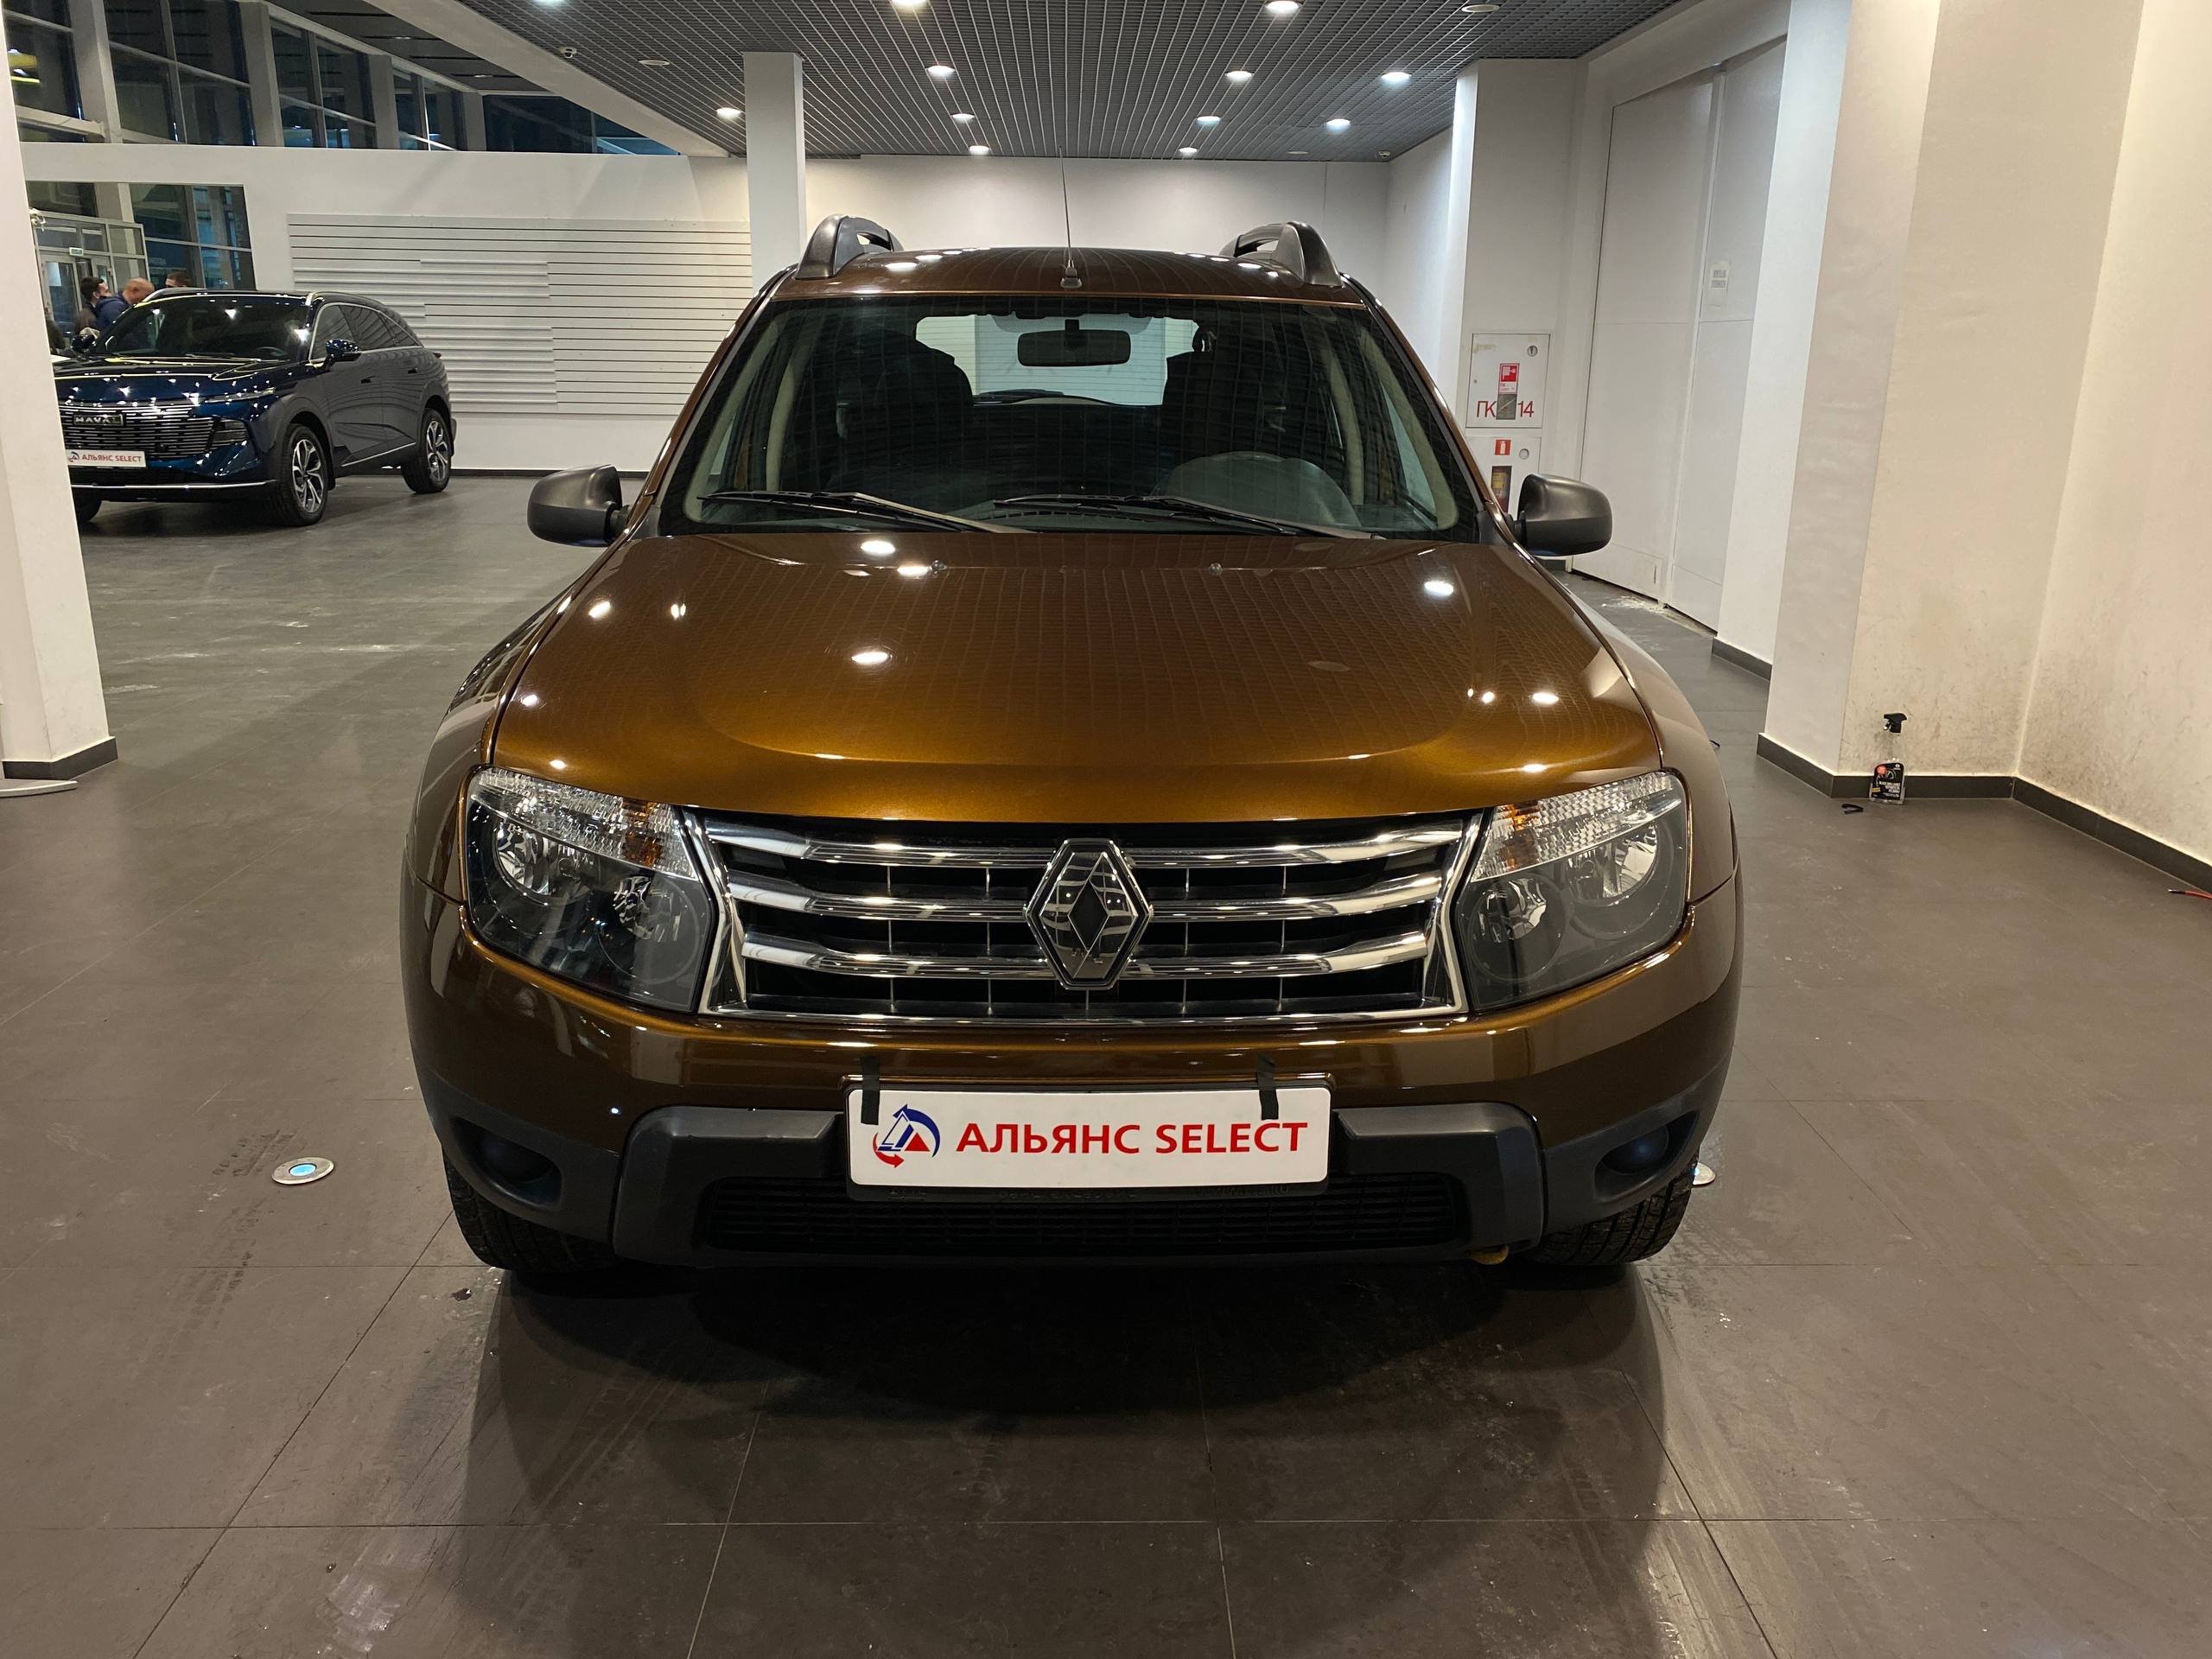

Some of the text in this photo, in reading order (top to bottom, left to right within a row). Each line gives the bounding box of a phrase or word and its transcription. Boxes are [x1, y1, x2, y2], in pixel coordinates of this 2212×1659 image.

[1477, 401, 1534, 417] ПК 14
[956, 1122, 1307, 1154] АЛЬЯНС SELECT
